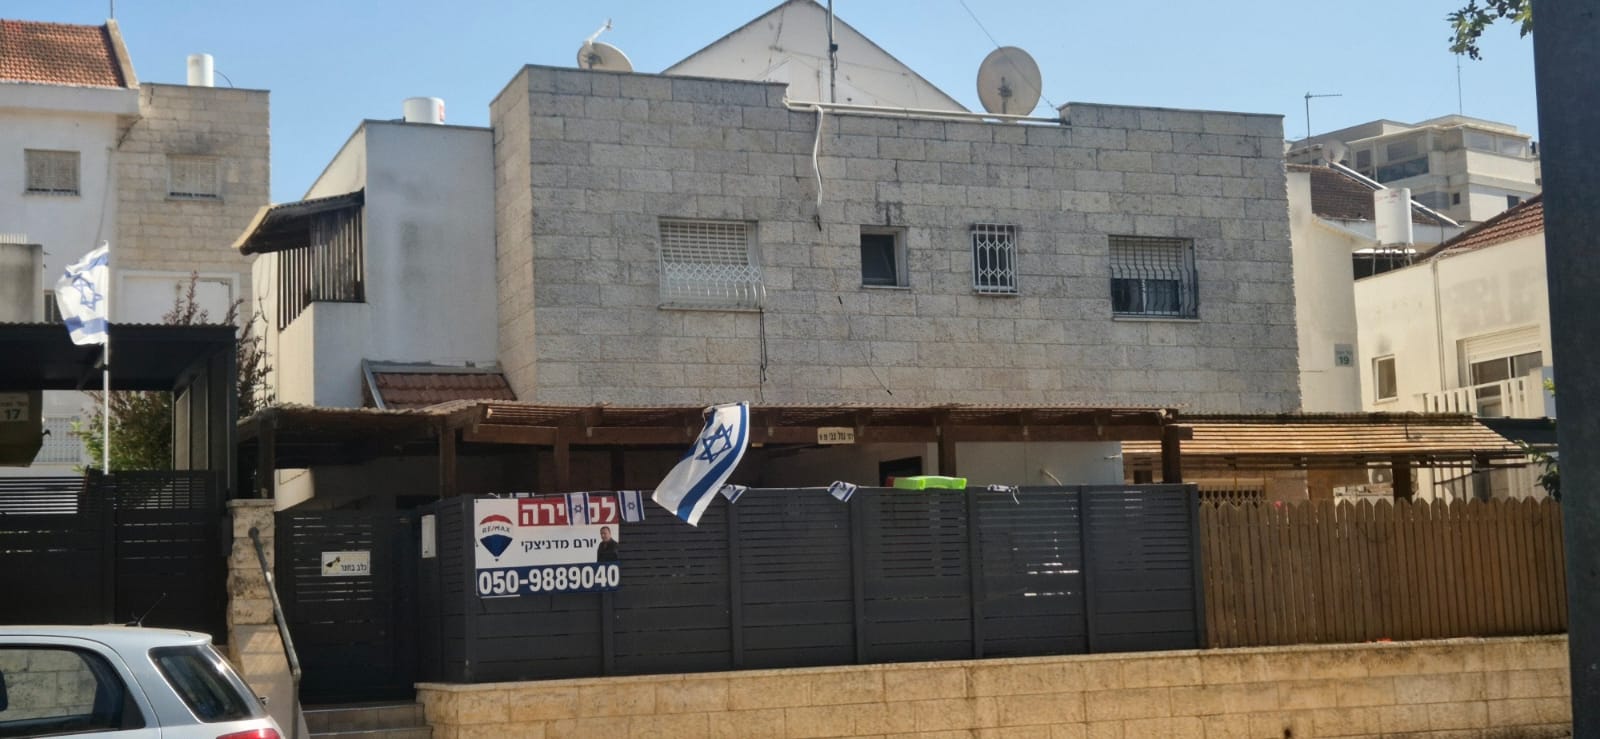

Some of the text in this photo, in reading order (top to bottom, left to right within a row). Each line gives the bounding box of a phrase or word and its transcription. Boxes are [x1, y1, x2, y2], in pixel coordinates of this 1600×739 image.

[1338, 355, 1350, 365] 19
[5, 408, 21, 420] 17
[482, 525, 510, 533] RE/MAX
[521, 538, 597, 553] יורם מדניצקי
[478, 564, 620, 595] 050-9889040
